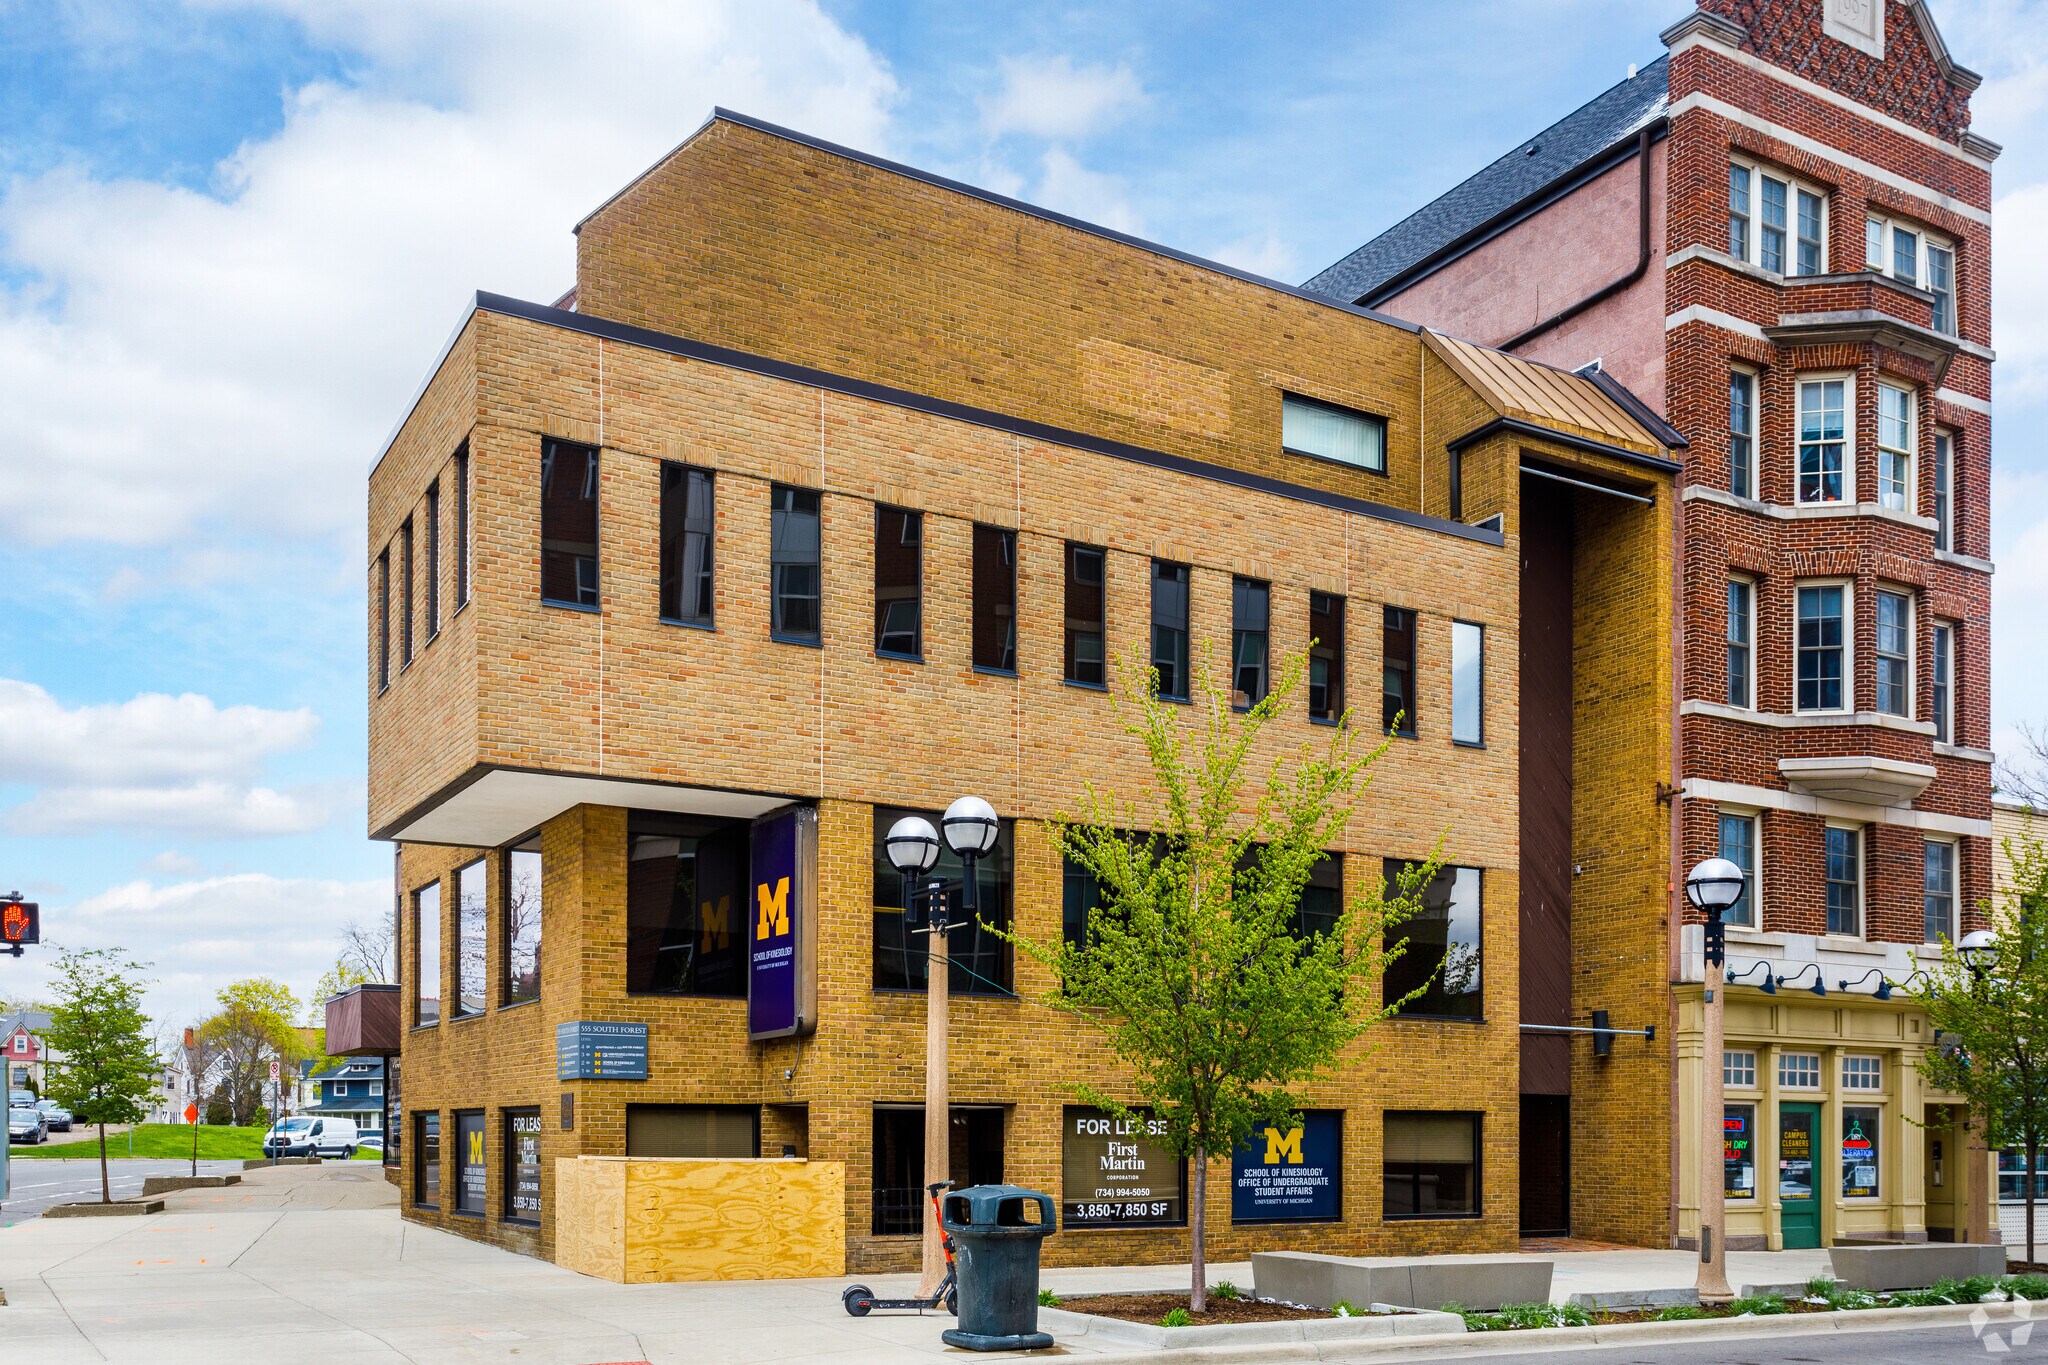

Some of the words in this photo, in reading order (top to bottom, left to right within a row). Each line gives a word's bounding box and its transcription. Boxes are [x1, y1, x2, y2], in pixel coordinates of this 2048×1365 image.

[757, 876, 790, 941] M
[620, 1026, 647, 1034] FOREST
[513, 1117, 526, 1132] FOR
[526, 1116, 541, 1132] LEAS
[1076, 1119, 1111, 1135] FOR
[1115, 1119, 1168, 1136] LESE
[1723, 1120, 1742, 1130] PEN
[1783, 1131, 1807, 1139] CAMPUS
[469, 1131, 483, 1165] M
[1107, 1141, 1138, 1156] First
[1264, 1127, 1304, 1165] M
[1723, 1140, 1732, 1149] SH
[1733, 1140, 1748, 1149] DRY
[1781, 1139, 1809, 1147] CLEANERS
[1724, 1149, 1741, 1159] OLD
[1100, 1156, 1145, 1170] Martin
[1244, 1168, 1270, 1178] SCHOOL
[1271, 1168, 1280, 1177] OF
[1281, 1167, 1323, 1177] KINESIOLOGY
[1238, 1178, 1261, 1187] OFFICE
[1262, 1178, 1271, 1187] OF
[1273, 1177, 1329, 1186] UNDERGRADUATE
[1095, 1188, 1115, 1198] (734)
[1116, 1188, 1150, 1197] 994-5050
[1254, 1187, 1284, 1197] STUDENT
[1285, 1186, 1313, 1196] AFFAIRS
[1077, 1203, 1148, 1219] 3,850-7,850
[1151, 1203, 1168, 1216] SF
